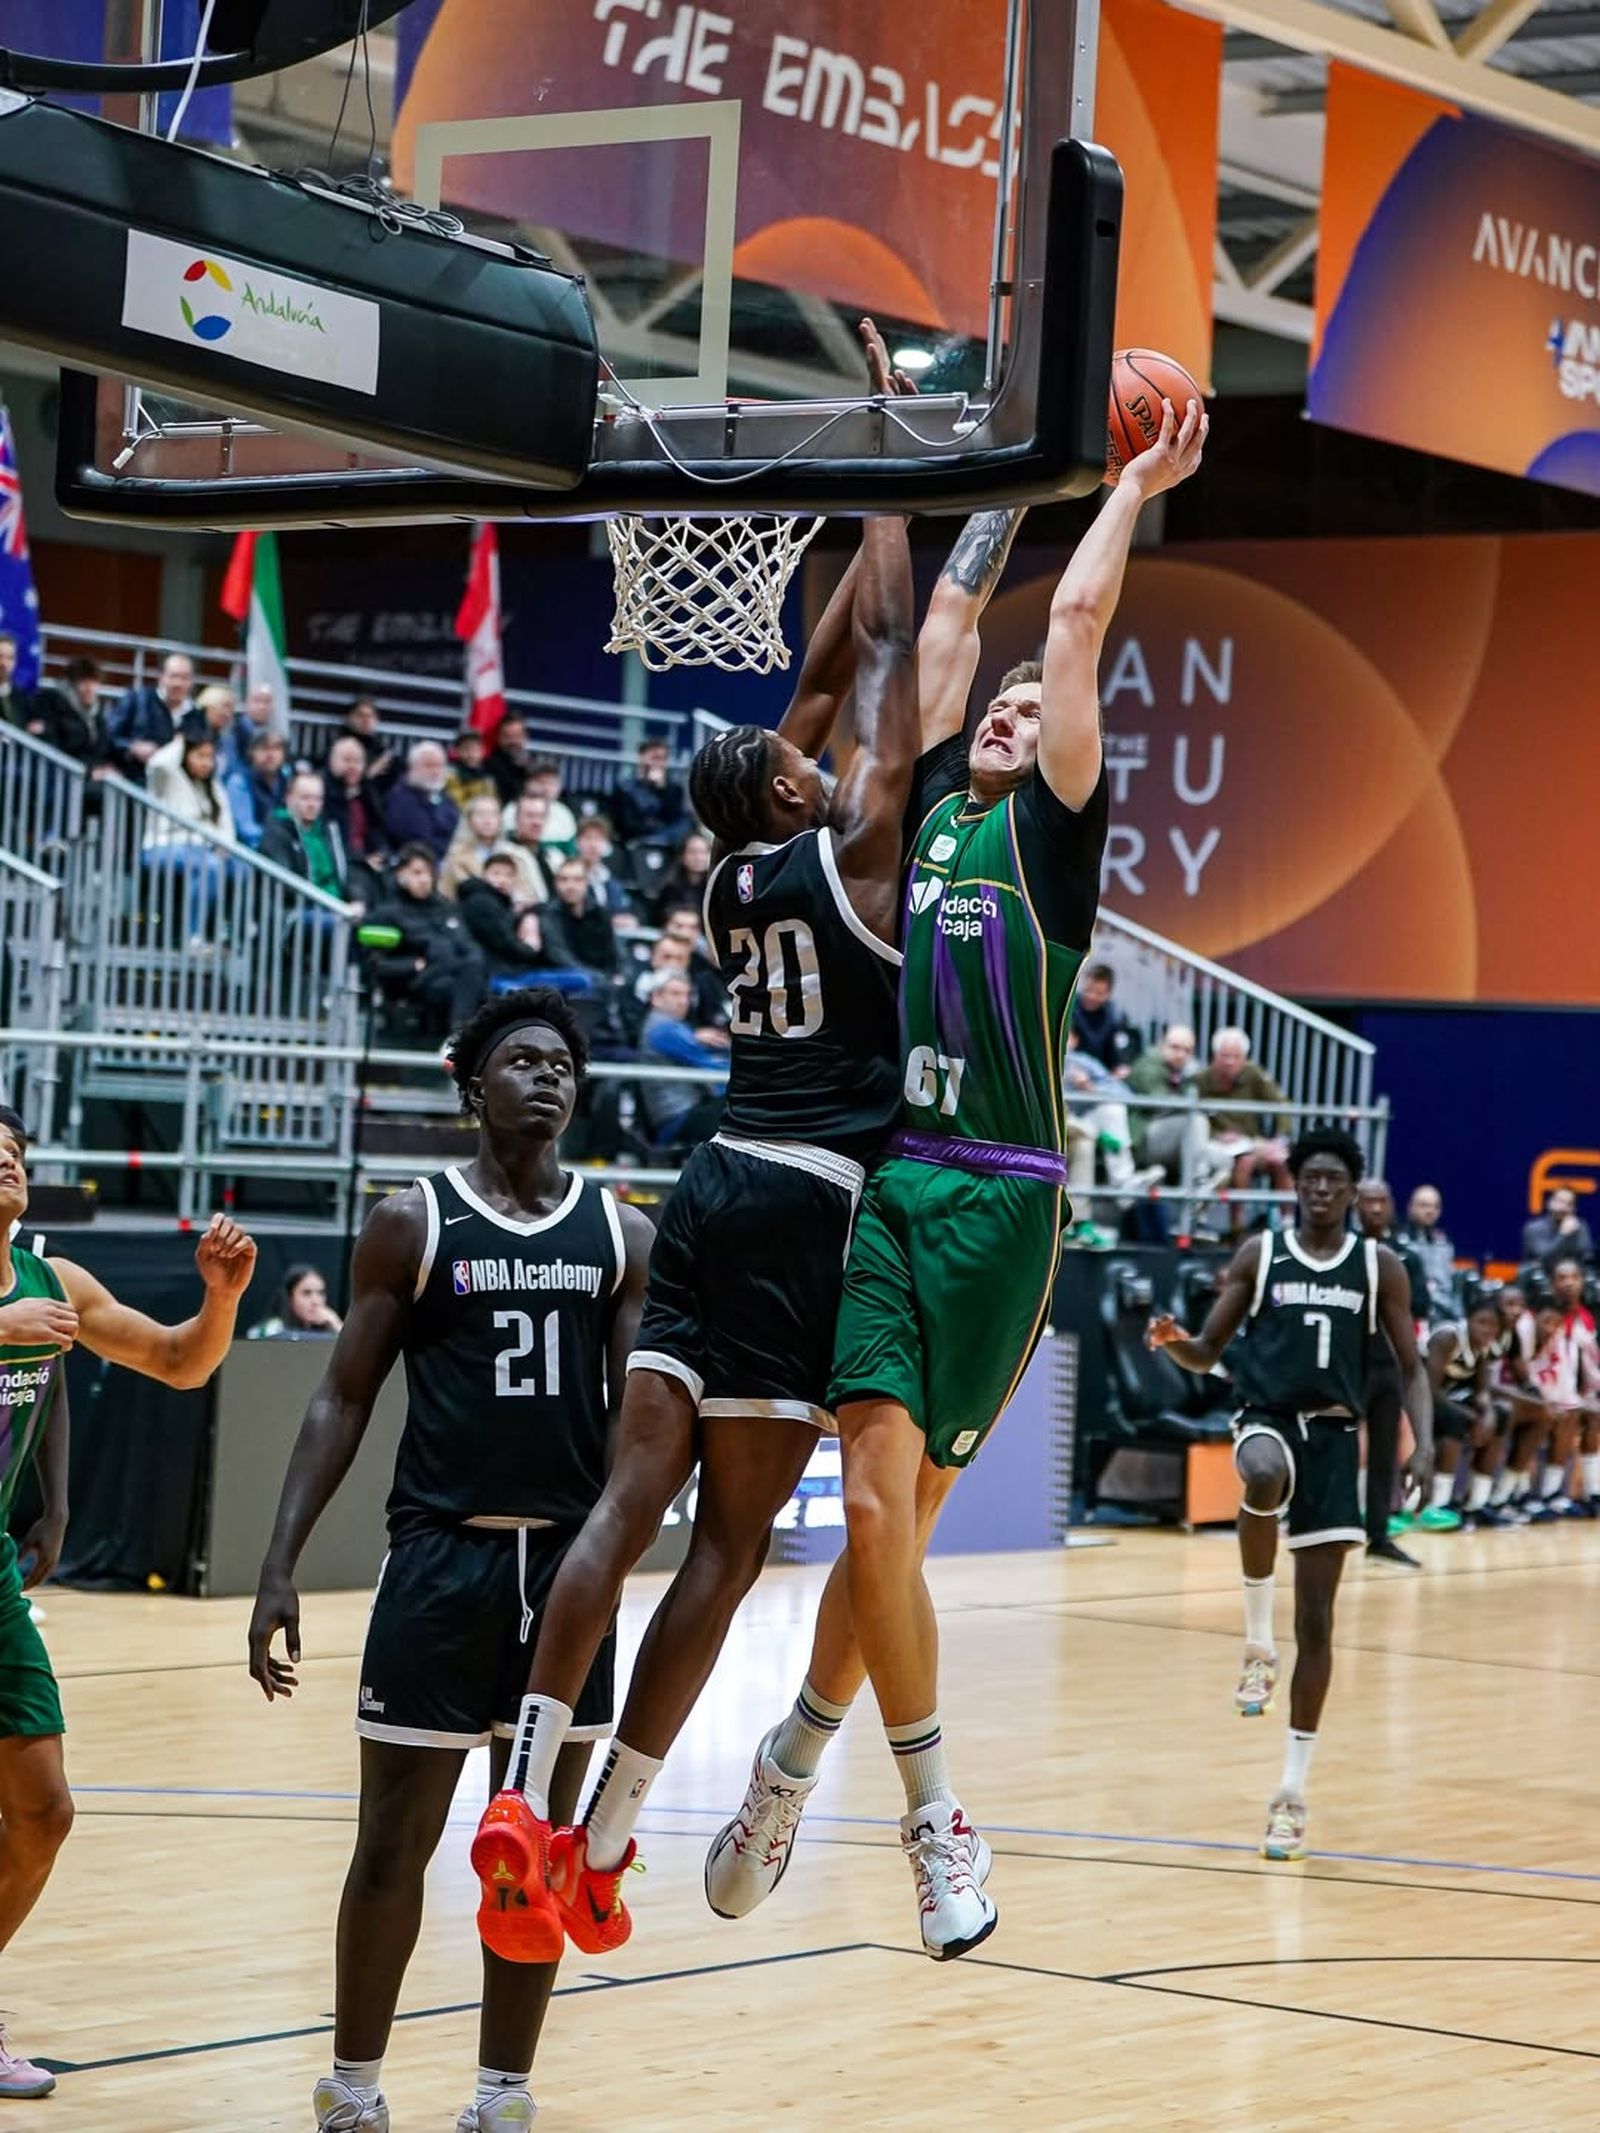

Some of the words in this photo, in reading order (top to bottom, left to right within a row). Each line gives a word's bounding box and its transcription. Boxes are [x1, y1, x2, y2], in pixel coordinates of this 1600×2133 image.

[594, 0, 735, 95] THE
[1472, 212, 1600, 300] AVANC
[727, 918, 824, 1039] 20
[904, 1045, 966, 1117] 67
[471, 1259, 512, 1292] NBA
[513, 1258, 603, 1299] Academy
[493, 1309, 560, 1397] 21
[1303, 1311, 1332, 1370] 7
